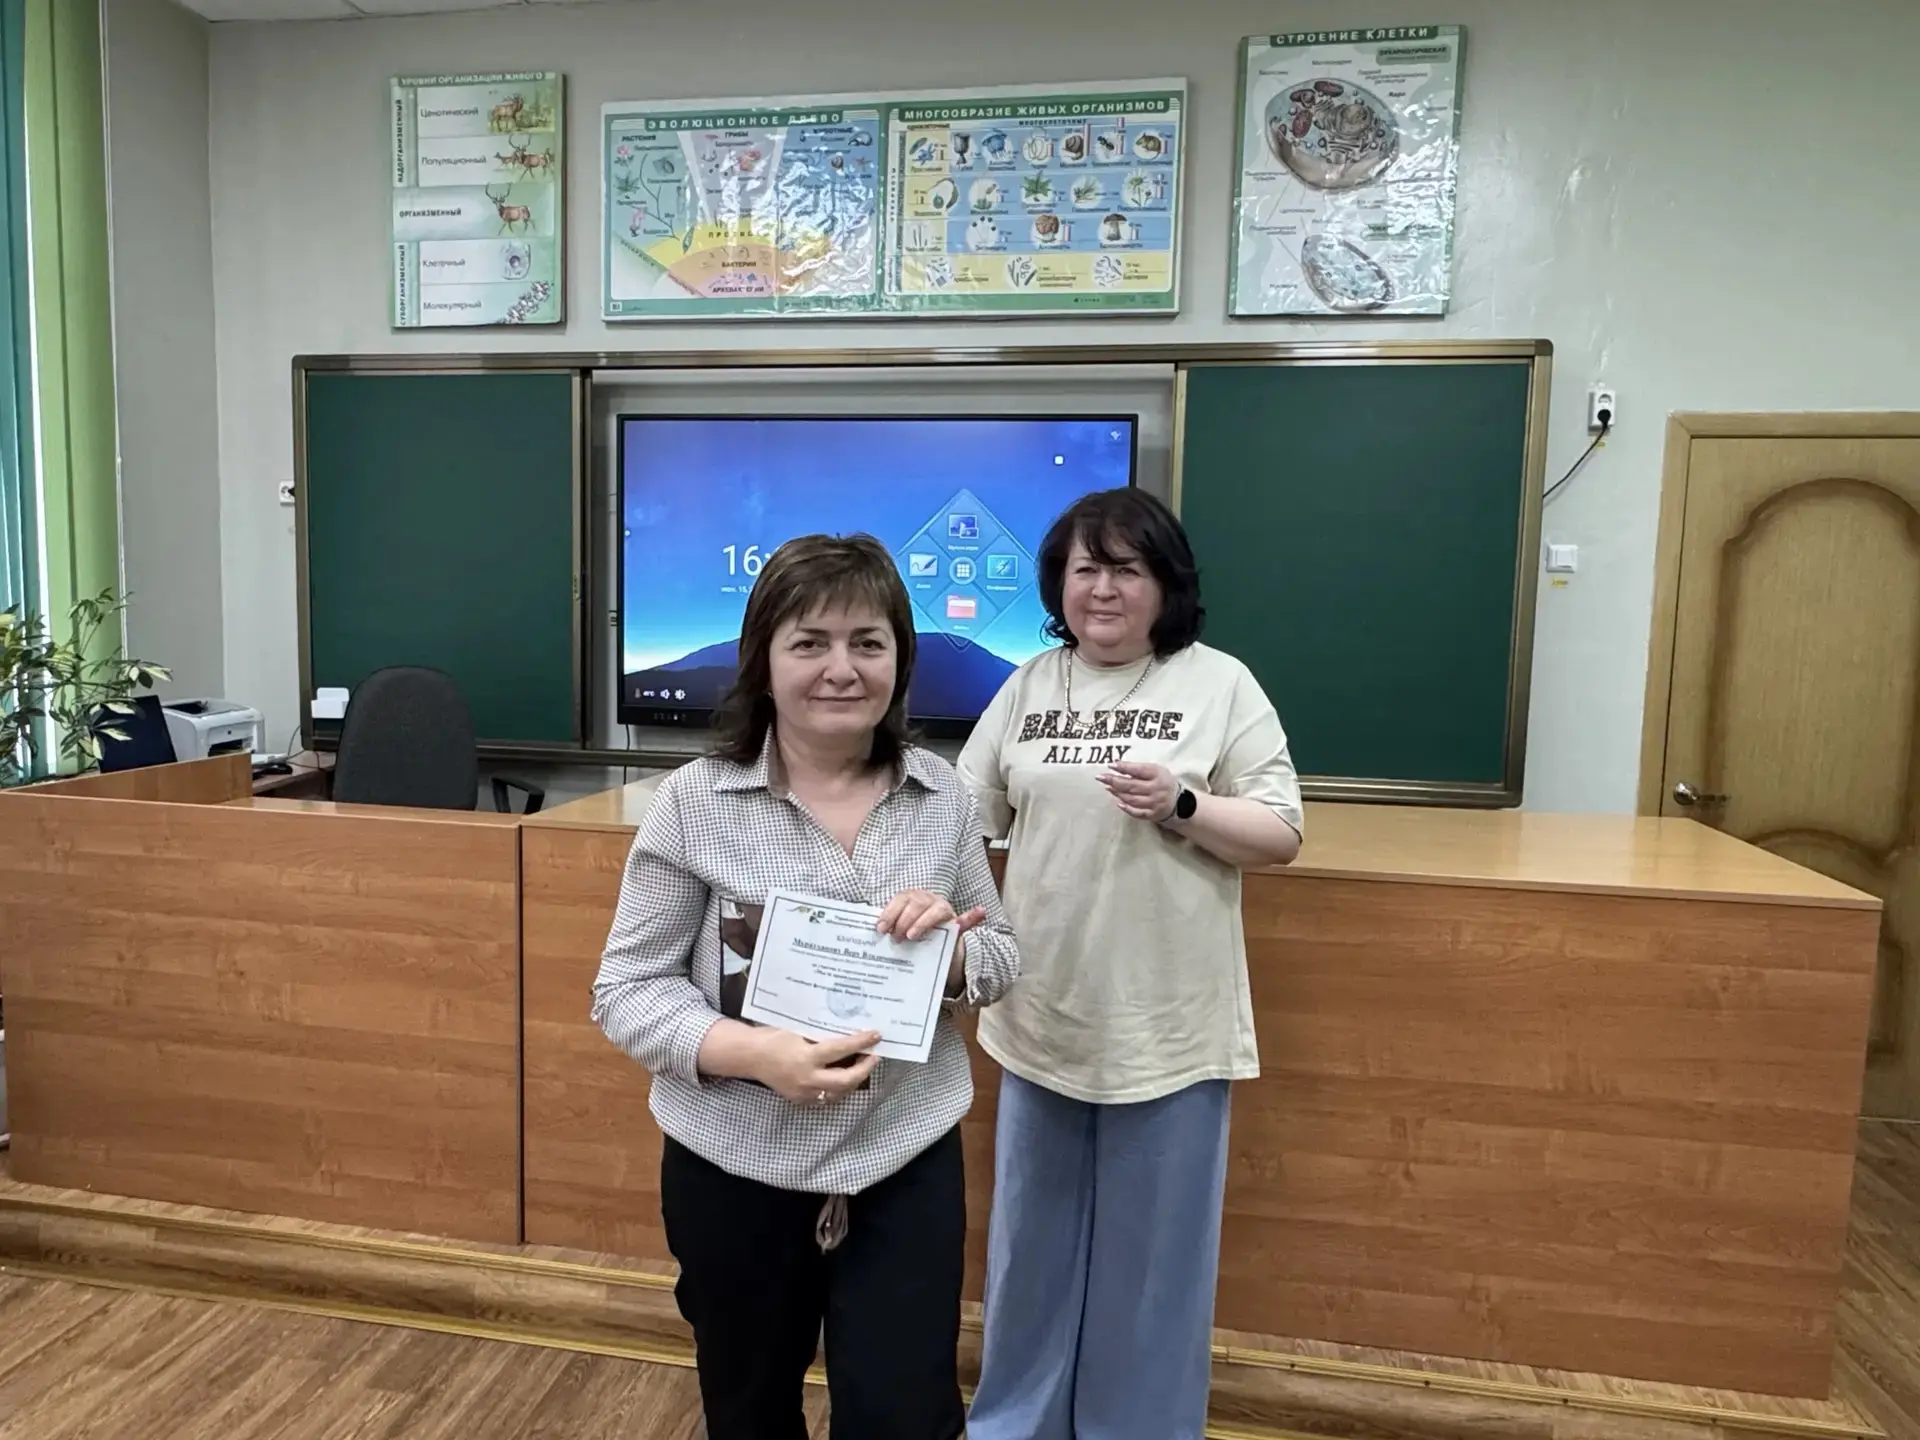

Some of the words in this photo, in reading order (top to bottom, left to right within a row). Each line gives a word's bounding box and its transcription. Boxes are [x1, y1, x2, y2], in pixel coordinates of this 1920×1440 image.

[1276, 31, 1358, 45] СТРОЕНИЕ
[1366, 27, 1428, 40] КЛЕТКИ
[904, 107, 1012, 120] МНОГООБРАЗИЕ
[1017, 105, 1067, 116] ЖИВЫХ
[1072, 100, 1165, 114] ОРГАНИЗМОВ
[648, 115, 779, 130] ЭВОЛЮЦИОННОЕ
[398, 207, 462, 218] ОРГАНИЗМЕННЫЙ
[722, 544, 771, 577] 16:
[1018, 709, 1183, 744] BALANCE
[1042, 745, 1082, 764] ALL
[1086, 745, 1131, 764] DAY
